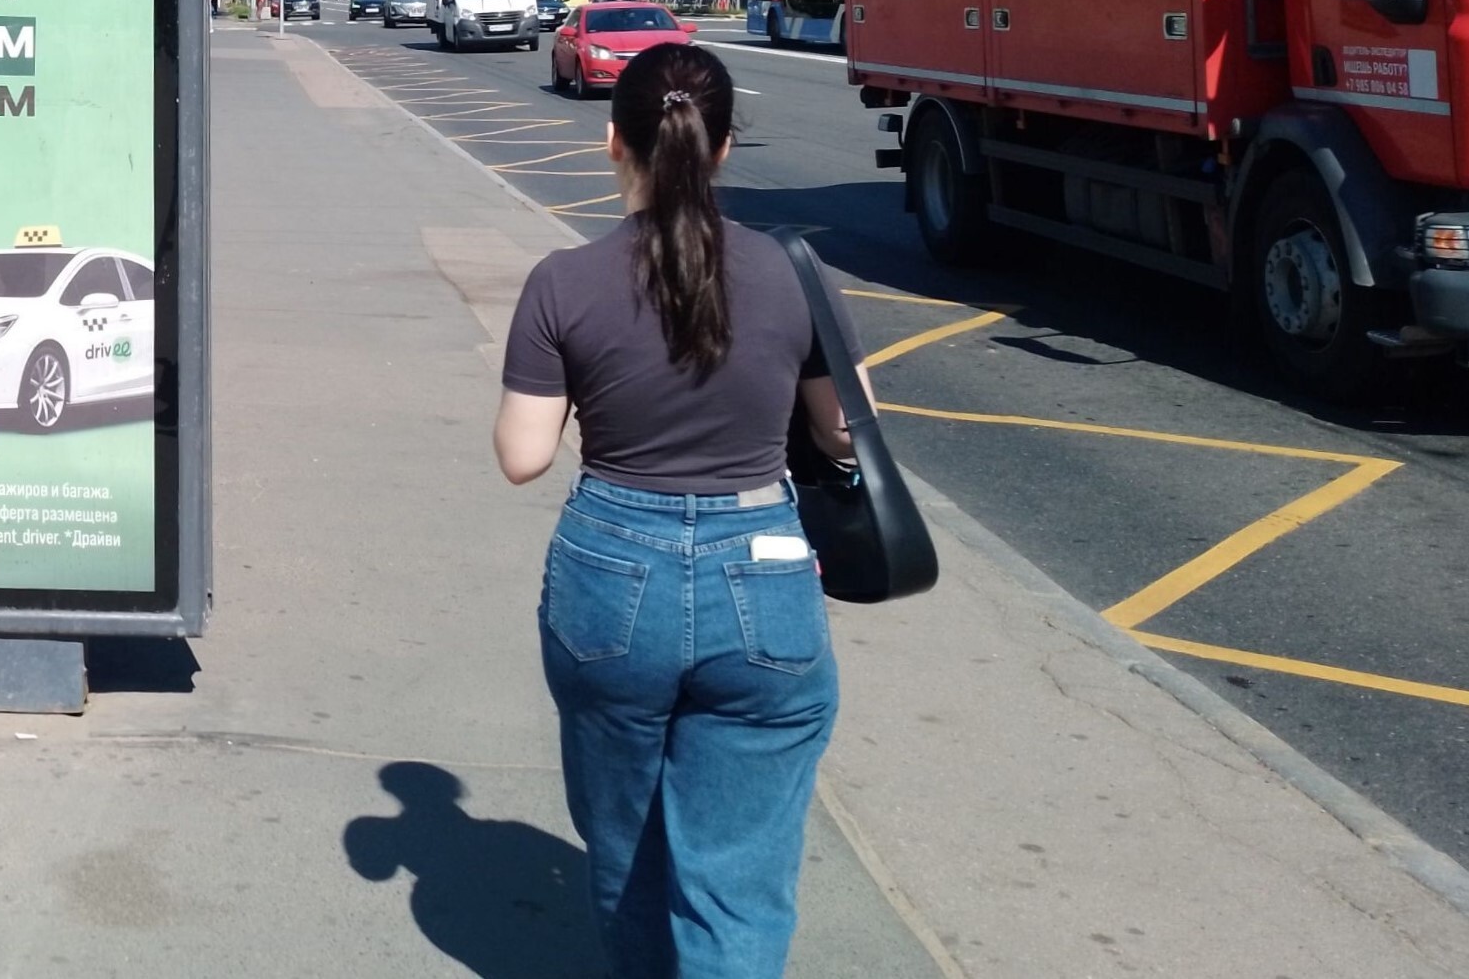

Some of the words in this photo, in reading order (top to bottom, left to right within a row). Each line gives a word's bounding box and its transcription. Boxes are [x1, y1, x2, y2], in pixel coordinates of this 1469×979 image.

[85, 340, 133, 361] drivee
[51, 485, 59, 497] и
[62, 482, 113, 499] багажа.
[42, 508, 118, 524] размещена
